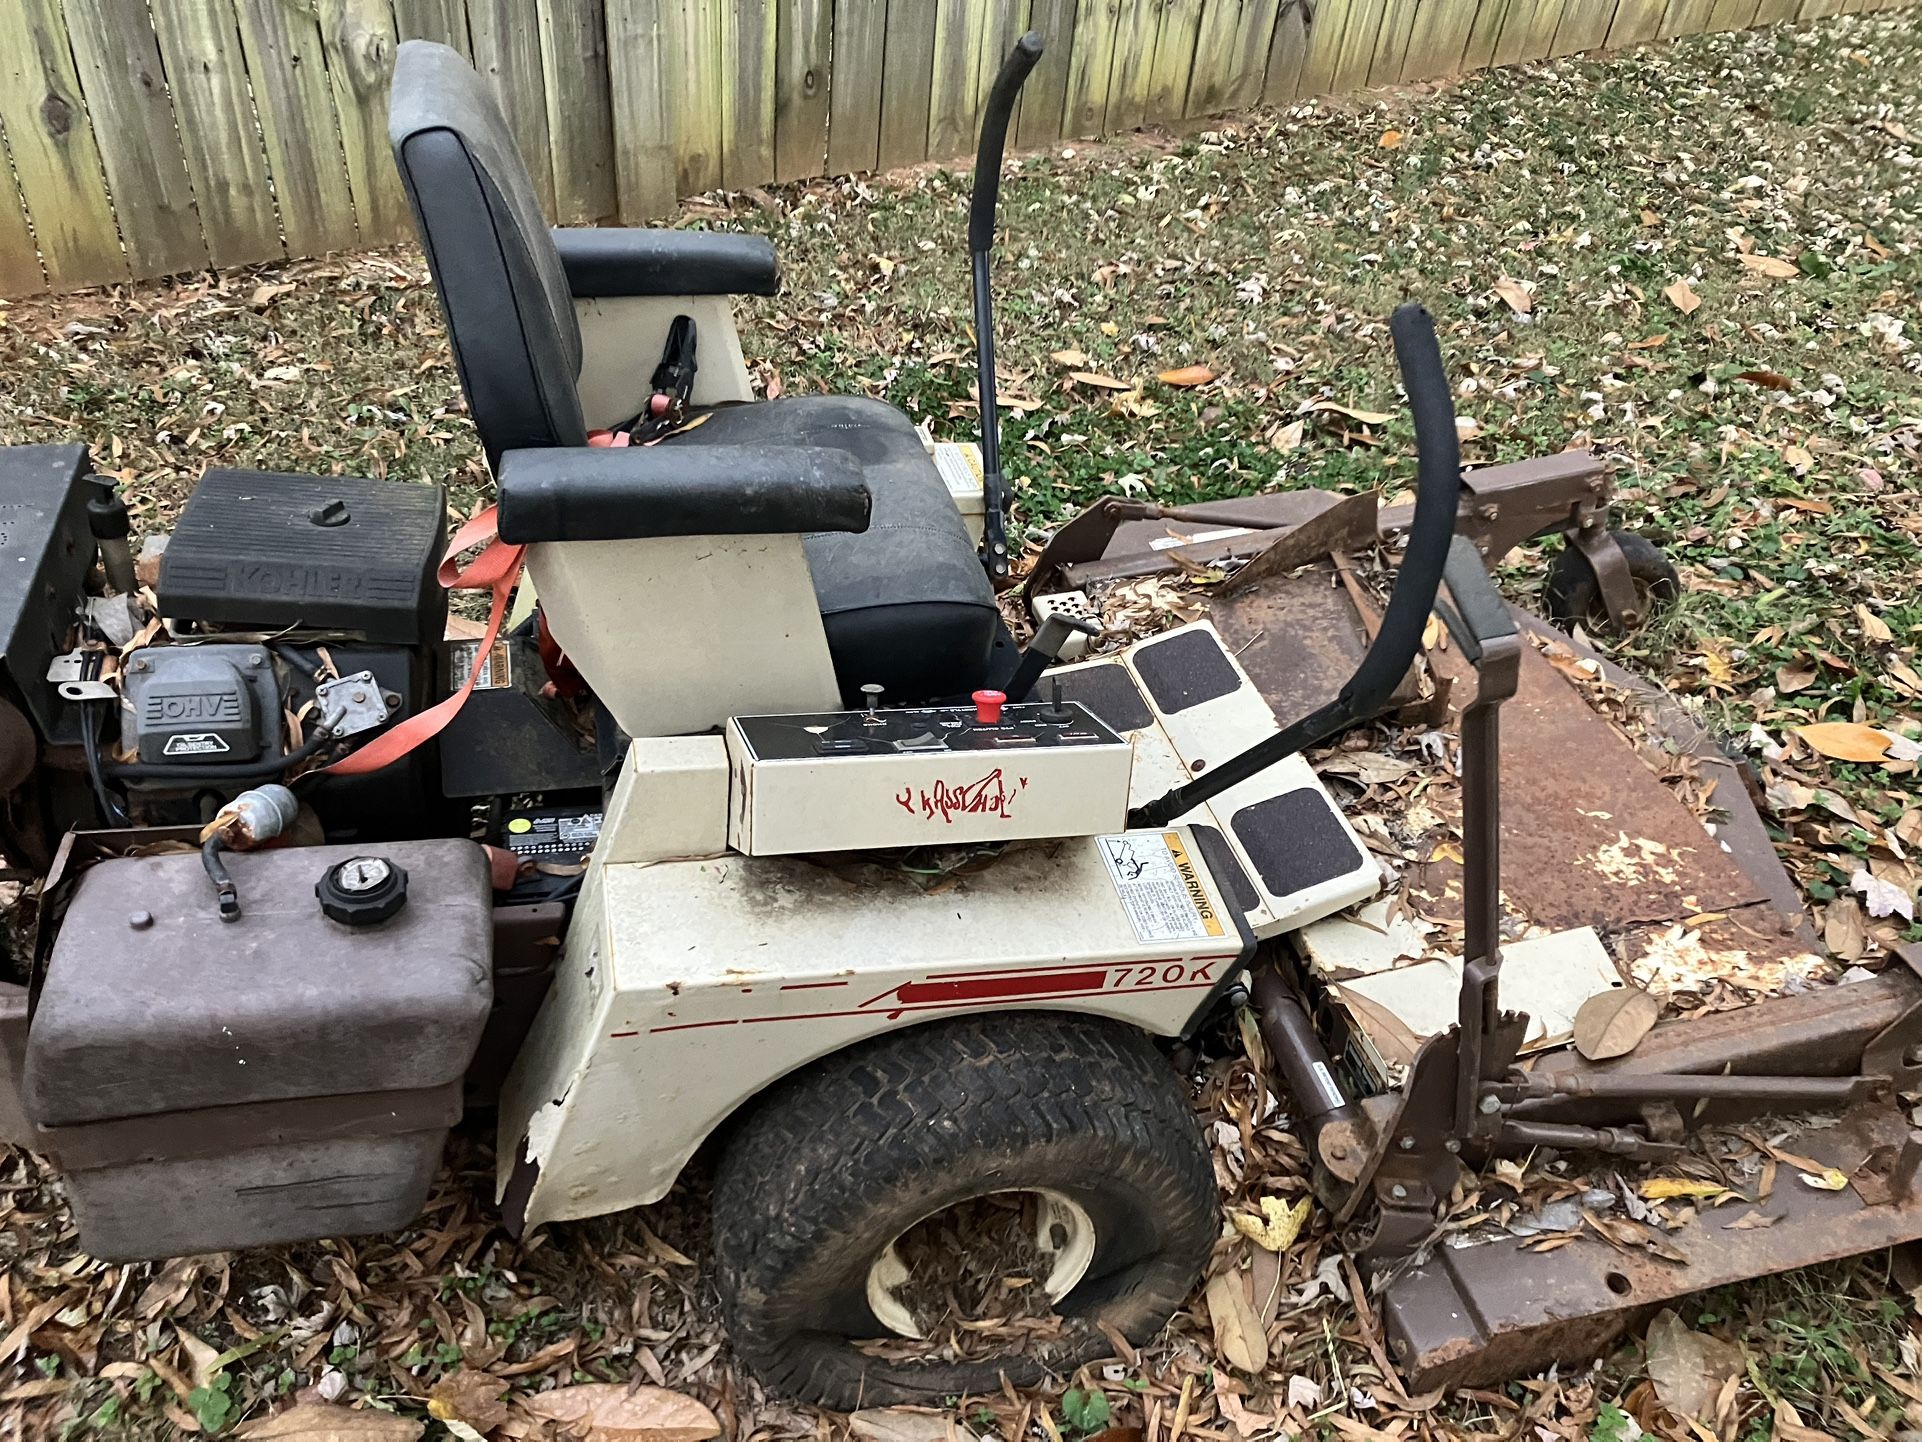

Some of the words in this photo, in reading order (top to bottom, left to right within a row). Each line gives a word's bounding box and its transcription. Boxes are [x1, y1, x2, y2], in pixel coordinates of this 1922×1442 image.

[231, 560, 364, 599] KOHLER
[163, 696, 223, 718] OHV
[1177, 862, 1214, 920] WARNING
[1113, 961, 1217, 988] 720K
